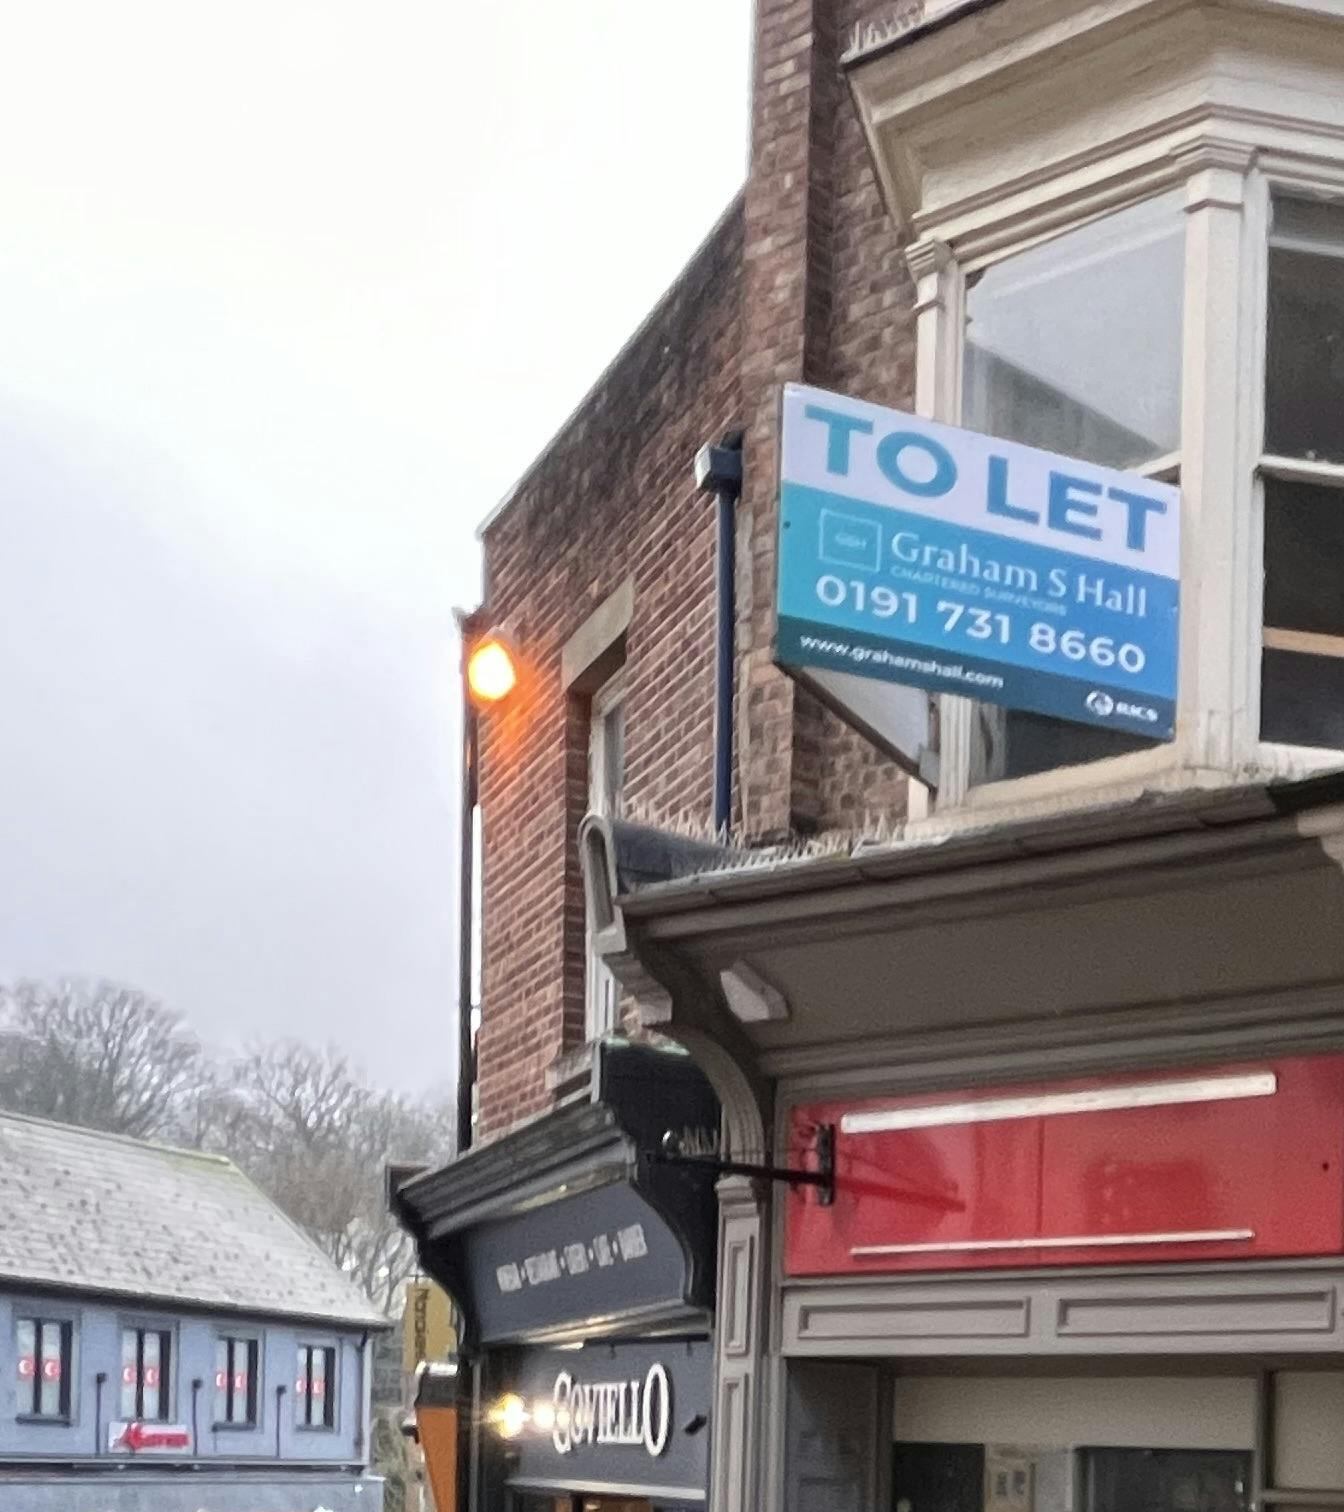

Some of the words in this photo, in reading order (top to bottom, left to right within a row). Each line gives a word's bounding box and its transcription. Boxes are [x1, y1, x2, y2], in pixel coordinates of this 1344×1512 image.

[804, 403, 958, 498] TO
[985, 453, 1168, 553] LET
[891, 531, 1038, 593] Graham
[1047, 567, 1068, 599] S
[1074, 572, 1149, 618] Hall
[799, 634, 1004, 689] www.grahamshall.com
[816, 574, 918, 624] 0191
[936, 599, 1010, 645] 731
[1028, 621, 1146, 674] 8660
